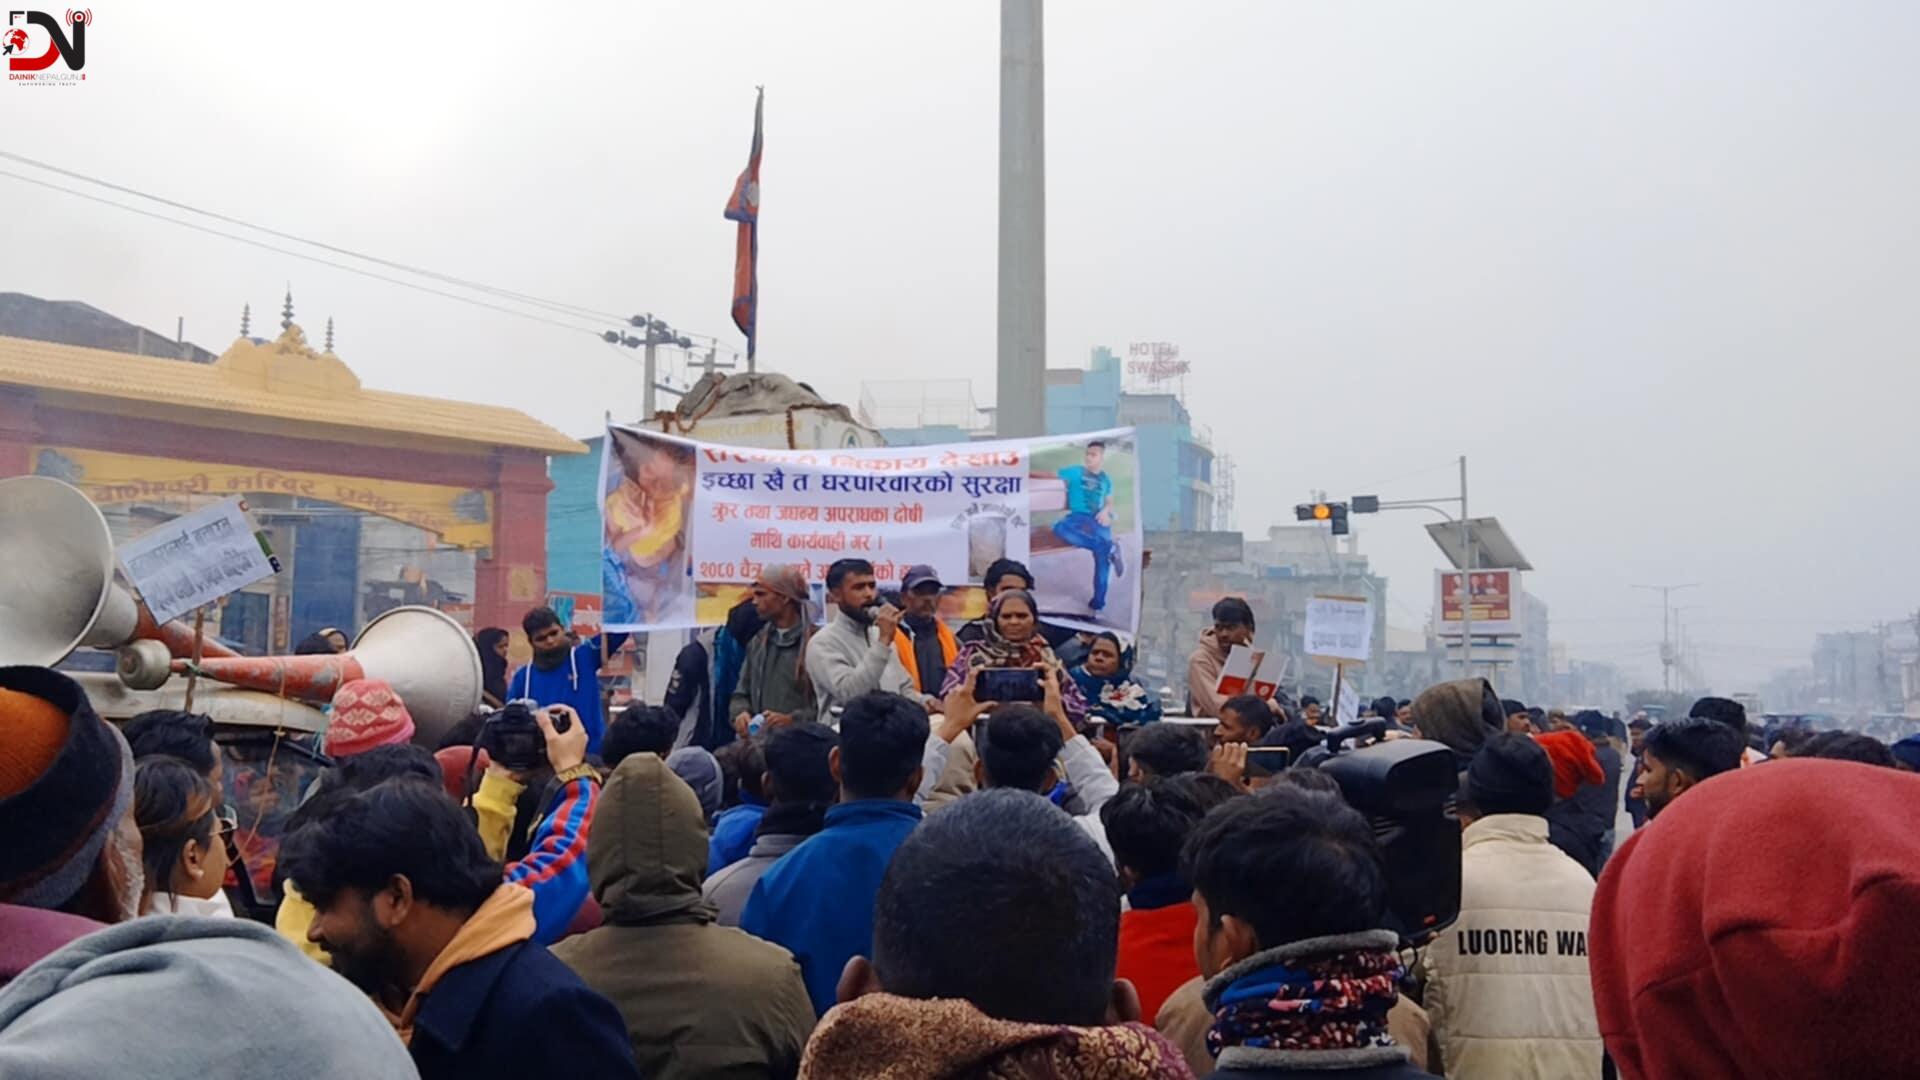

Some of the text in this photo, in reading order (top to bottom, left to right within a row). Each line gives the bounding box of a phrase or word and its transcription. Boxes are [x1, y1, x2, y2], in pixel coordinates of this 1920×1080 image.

[1129, 342, 1175, 355] HOTEL
[702, 472, 755, 490] इच्छा
[792, 473, 808, 491] त
[961, 476, 1021, 497] सुरक्षा
[750, 527, 782, 549] माथि
[1458, 930, 1548, 955] LUODENG
